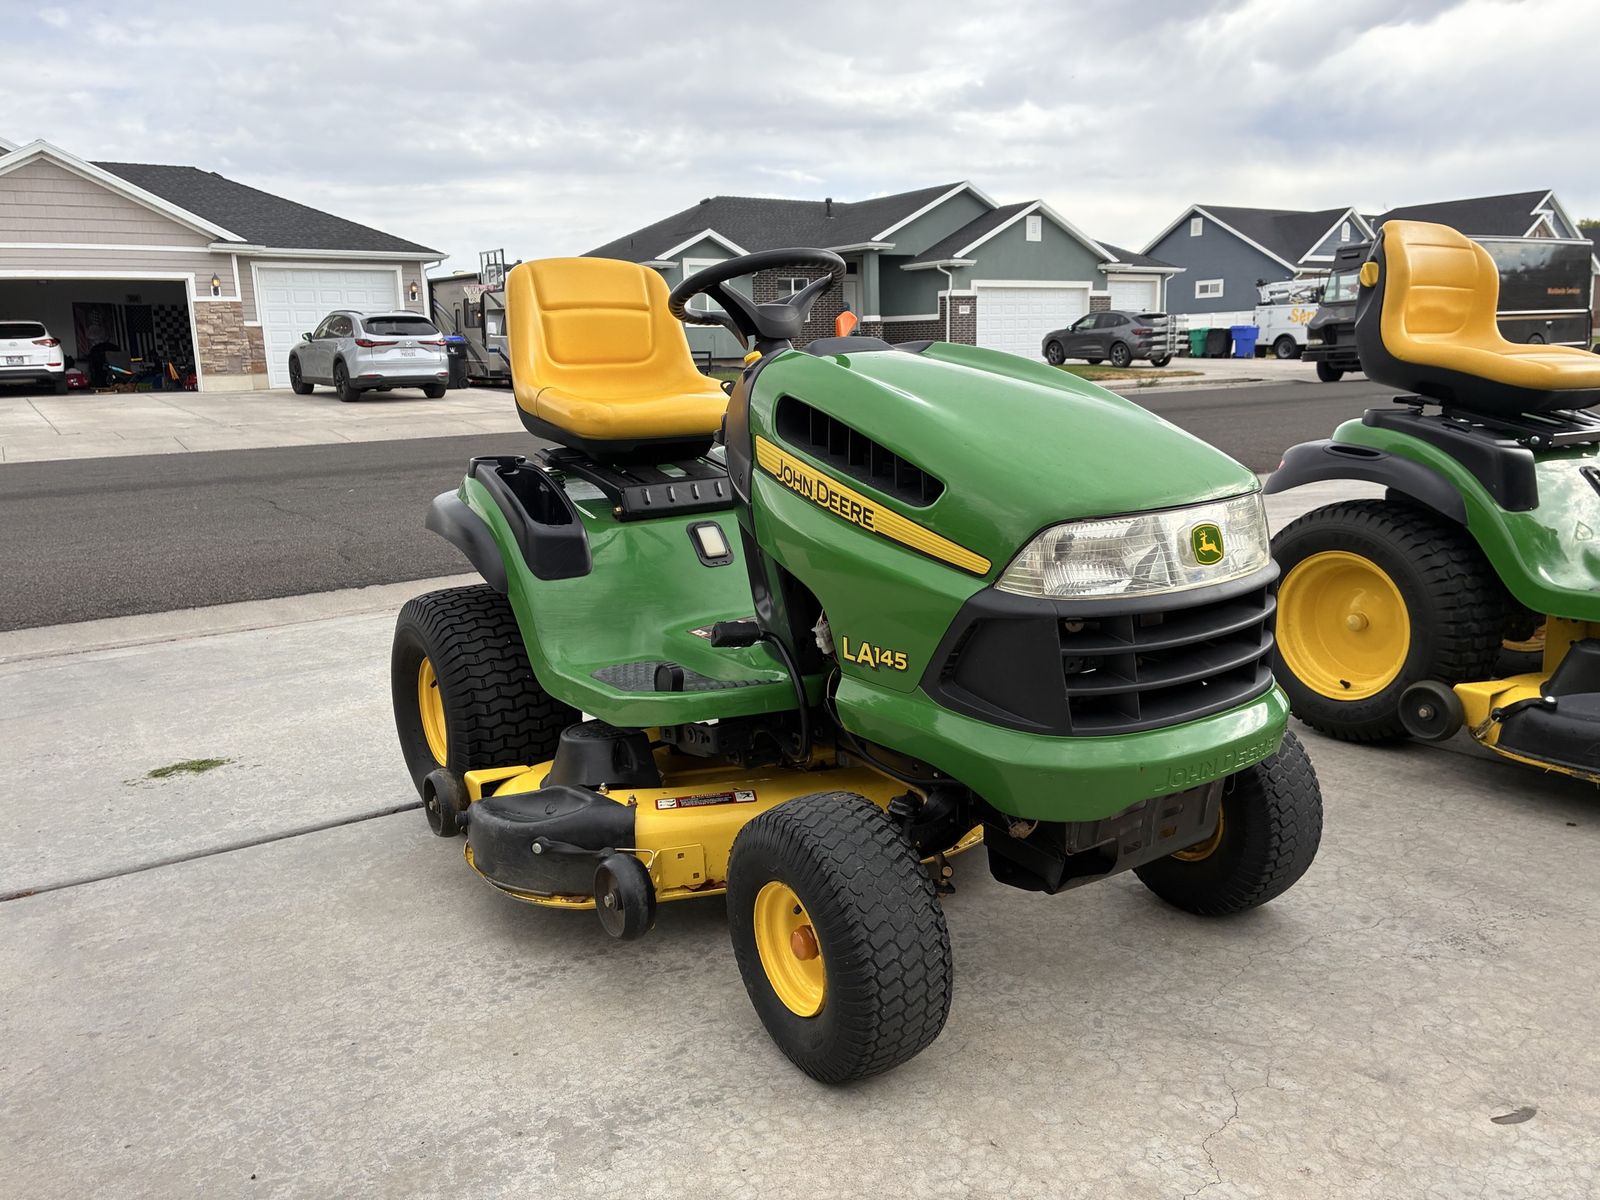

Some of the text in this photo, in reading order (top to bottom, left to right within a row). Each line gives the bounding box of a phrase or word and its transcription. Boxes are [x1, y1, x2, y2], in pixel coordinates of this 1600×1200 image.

[776, 459, 875, 529] JOHN DEERE
[842, 635, 908, 671] LA145
[1153, 737, 1276, 792] JOHN DEERE
